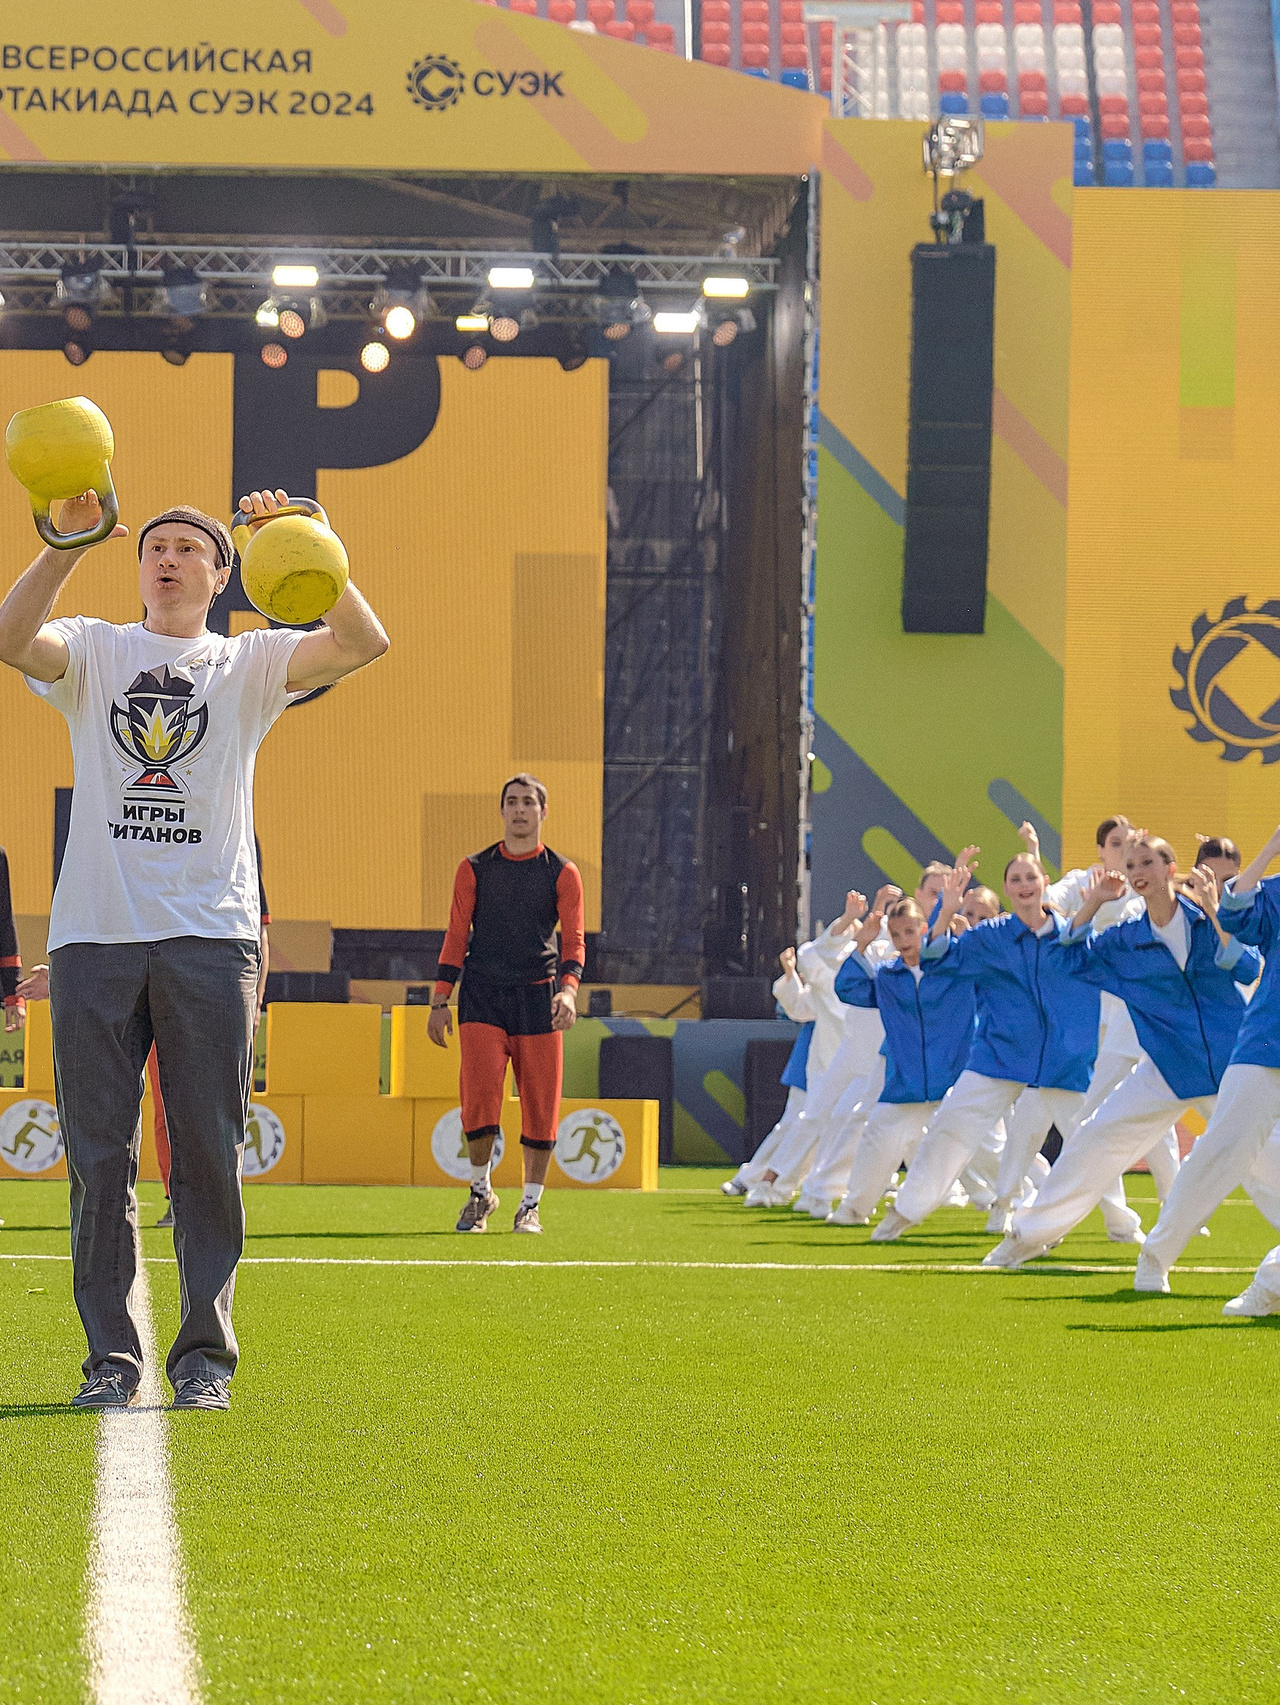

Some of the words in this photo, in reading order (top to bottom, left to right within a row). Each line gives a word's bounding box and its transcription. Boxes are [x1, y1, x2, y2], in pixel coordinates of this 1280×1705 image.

[2, 41, 312, 73] ВСЕРОССИЙСКАЯ
[473, 70, 565, 97] СУЭК
[188, 89, 278, 115] СУЭК
[289, 91, 374, 116] 2024
[123, 804, 185, 823] ИГРЫ
